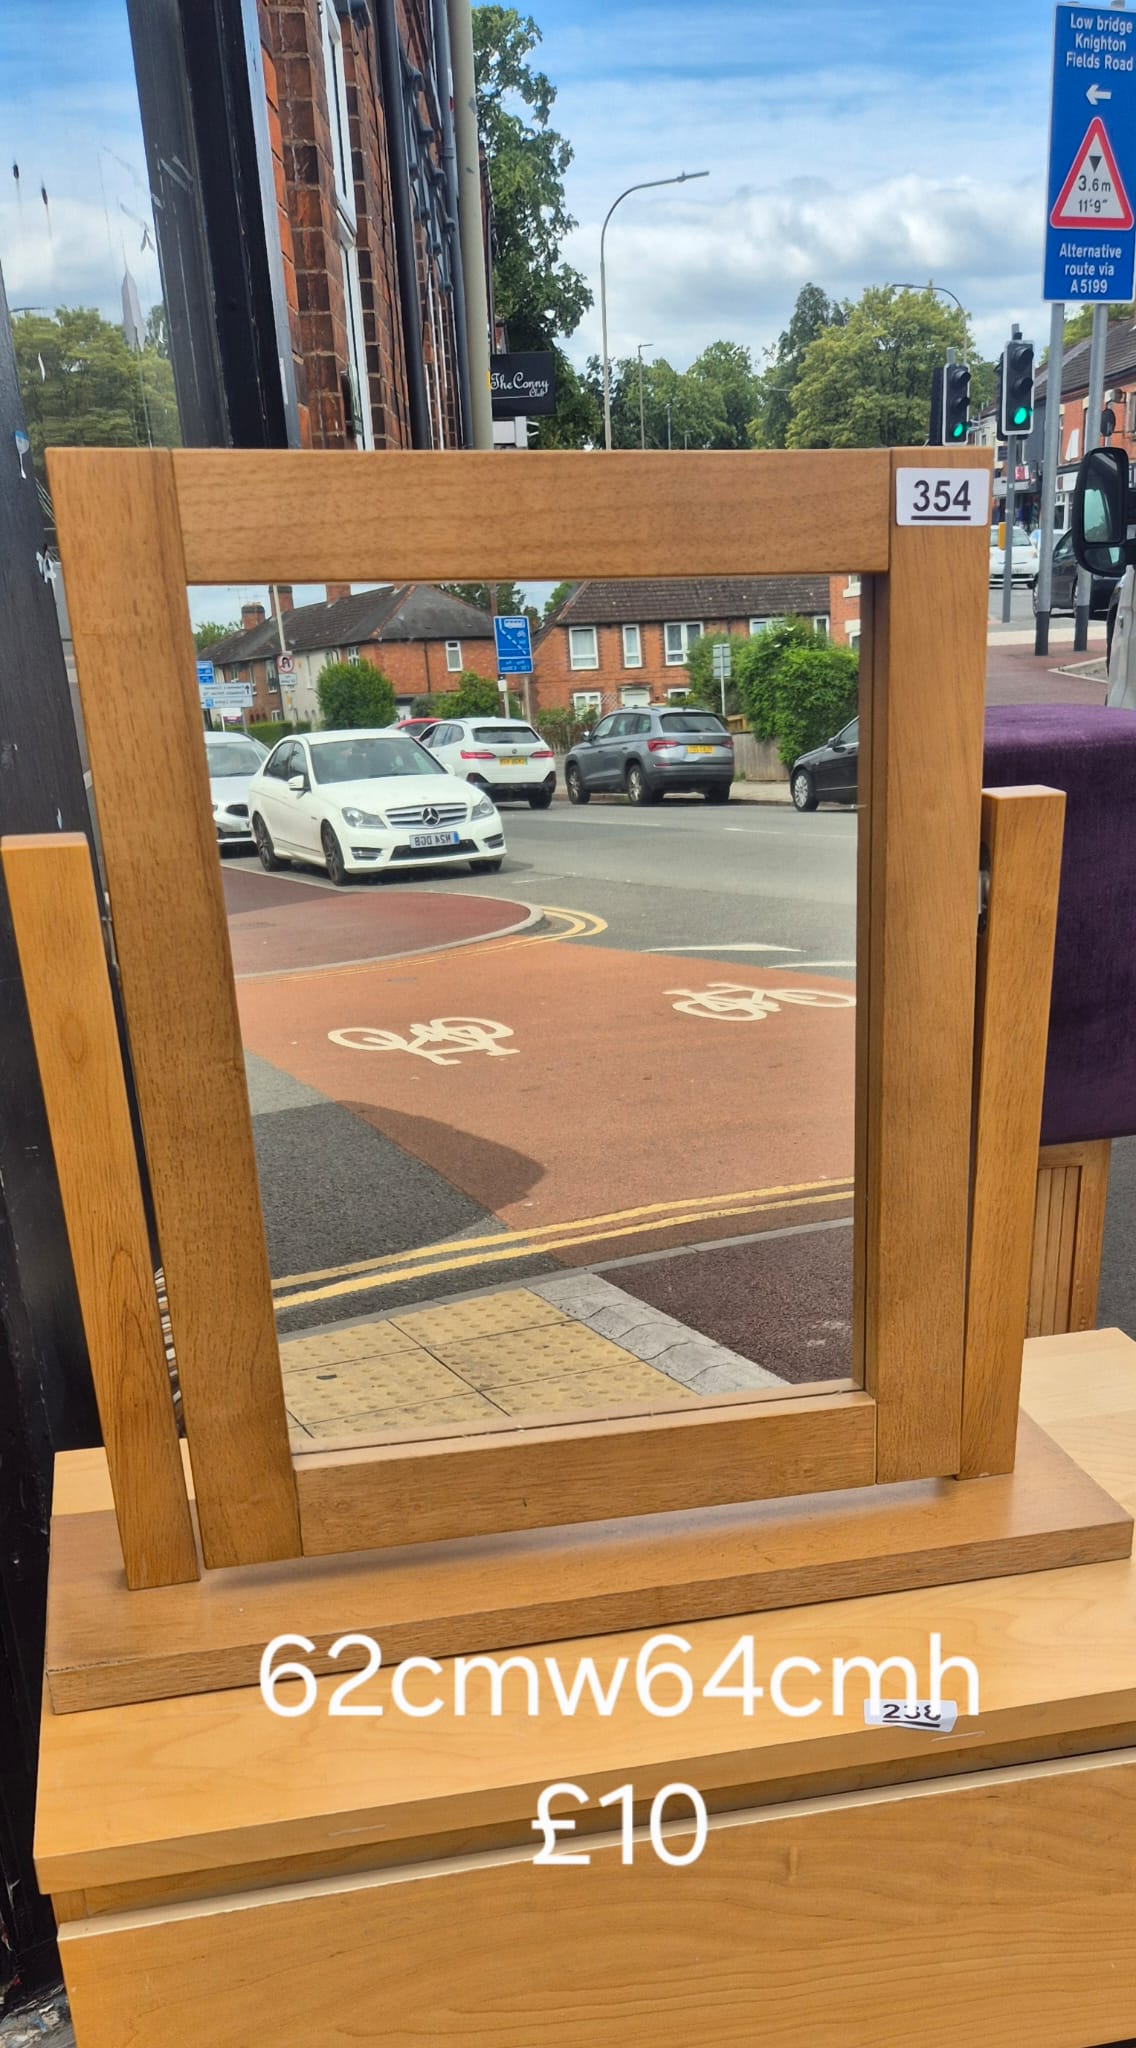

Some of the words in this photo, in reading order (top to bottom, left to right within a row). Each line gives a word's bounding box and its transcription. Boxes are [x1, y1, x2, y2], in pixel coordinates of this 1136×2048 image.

[1070, 12, 1093, 31] Low
[1096, 15, 1133, 36] bridge
[1075, 33, 1127, 53] Knighton
[1065, 51, 1100, 69] Fields
[1104, 54, 1134, 72] Road
[1059, 242, 1122, 259] Alternative
[1064, 263, 1096, 277] route
[1098, 261, 1115, 277] via
[1070, 279, 1108, 295] A5199
[490, 372, 513, 391] The
[913, 479, 971, 512] 354
